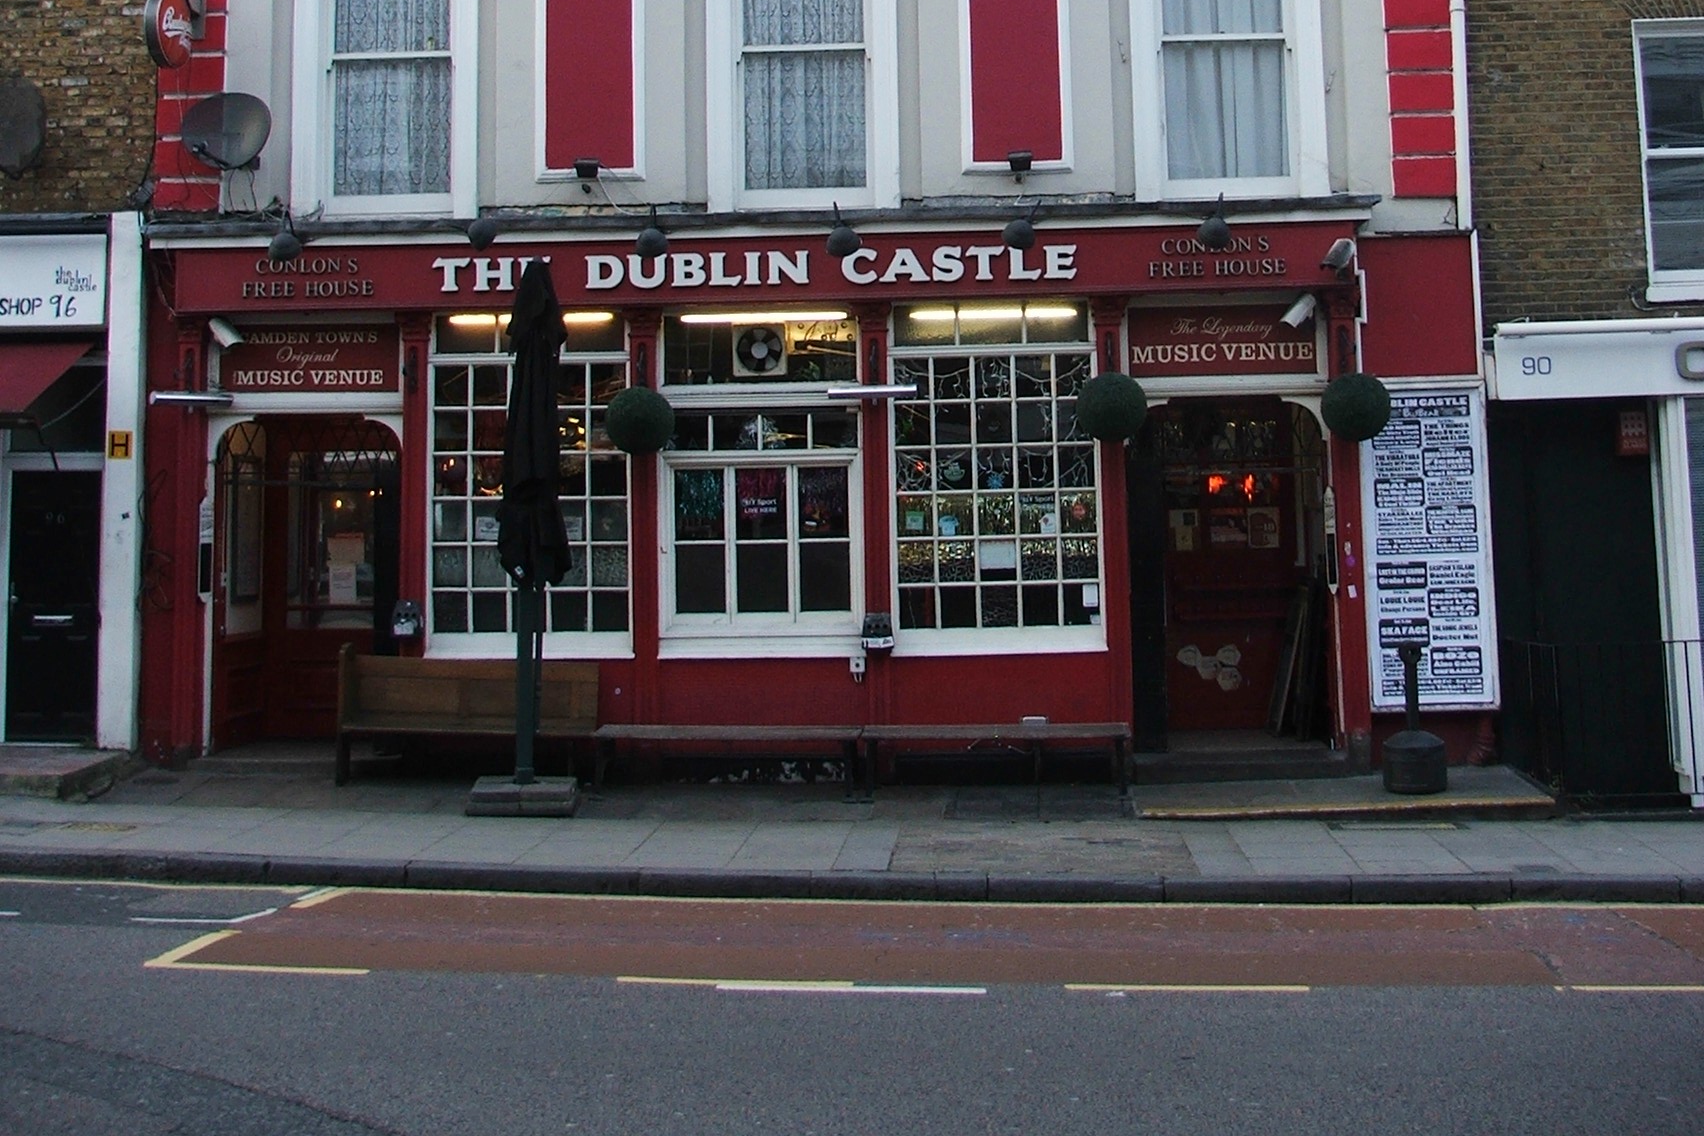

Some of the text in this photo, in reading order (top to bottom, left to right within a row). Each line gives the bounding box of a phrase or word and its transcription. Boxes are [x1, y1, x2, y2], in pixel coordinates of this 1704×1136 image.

[585, 250, 810, 289] DUBLIN
[841, 244, 1078, 284] CASTLE
[1149, 258, 1287, 277] FREE HOUSE
[242, 279, 374, 297] FREE HOUSE
[0, 294, 77, 318] SHOP 96
[1170, 316, 1273, 341] The Legendary
[276, 346, 339, 369] Original
[1132, 342, 1313, 364] MUSIC VENUE
[1521, 356, 1552, 375] 90
[237, 369, 384, 385] MUSIC VENUE
[1418, 396, 1468, 406] CASTLE
[111, 433, 129, 457] H
